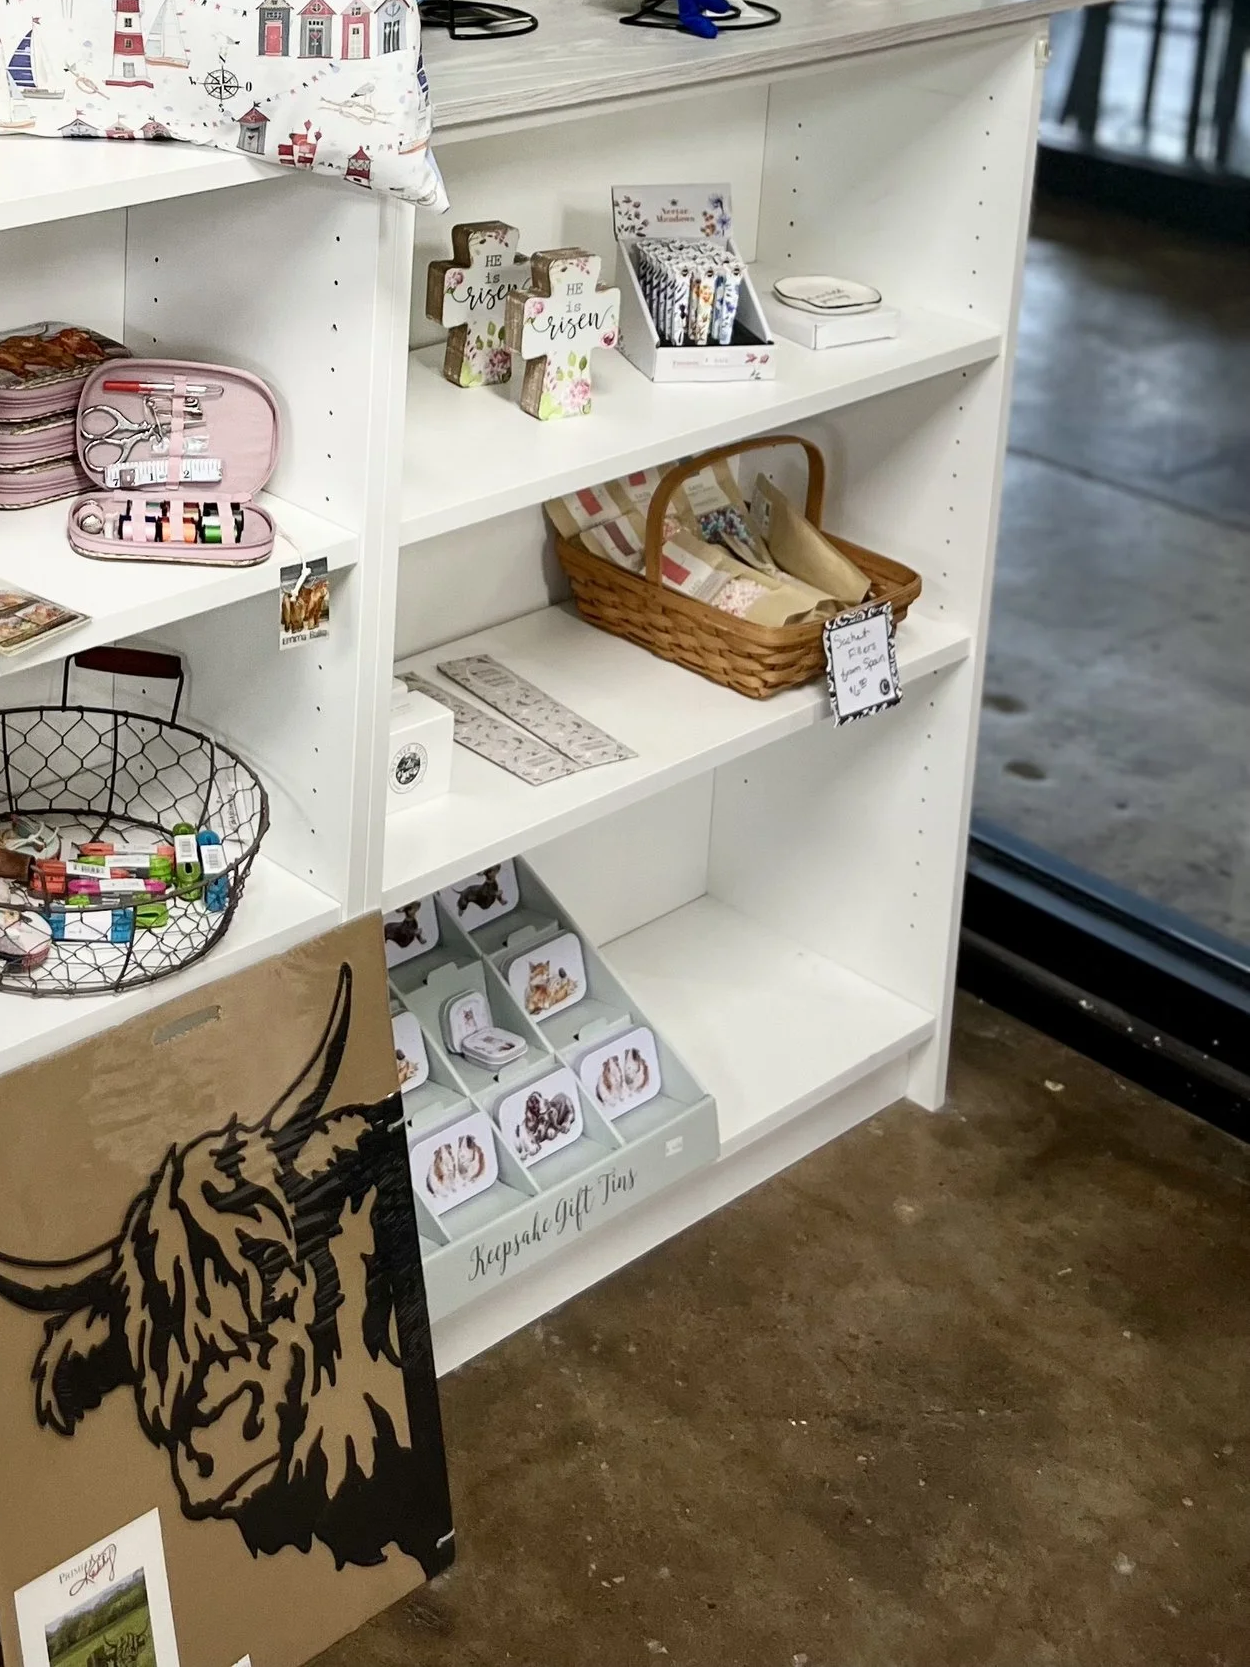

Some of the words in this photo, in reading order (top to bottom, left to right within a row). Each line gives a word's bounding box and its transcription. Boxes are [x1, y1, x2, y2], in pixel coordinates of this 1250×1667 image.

[485, 254, 502, 268] HE
[485, 272, 500, 285] is
[451, 277, 531, 310] risen
[566, 282, 584, 296] HE
[566, 301, 581, 313] is
[531, 305, 614, 340] risen
[468, 1211, 551, 1281] Keepsake
[554, 1184, 595, 1234] Gift
[597, 1167, 638, 1206] Tins
